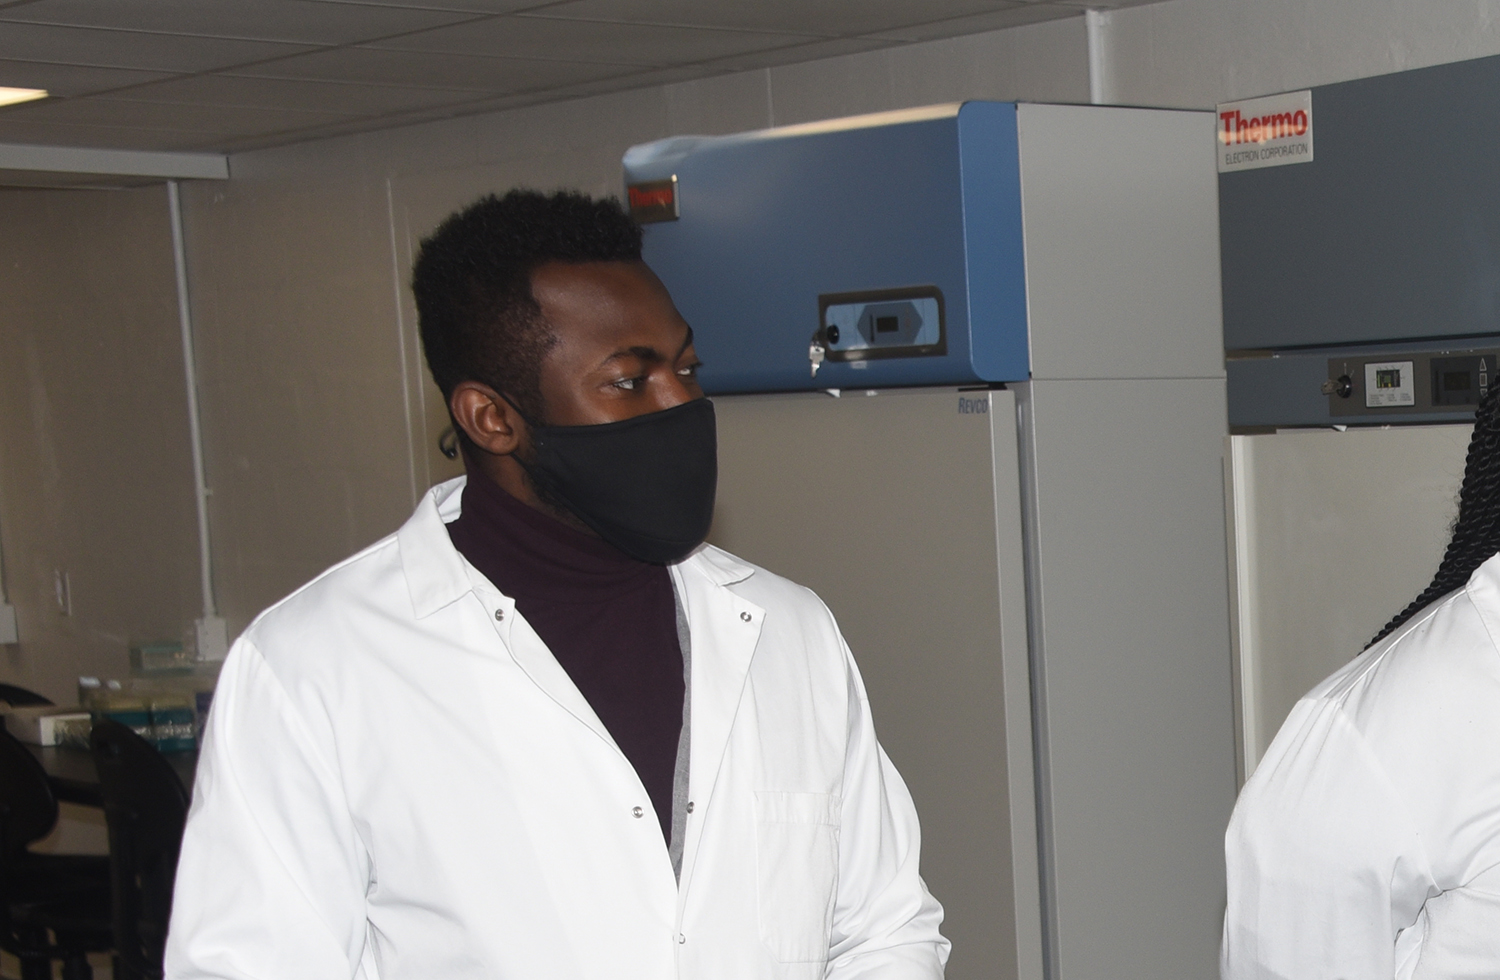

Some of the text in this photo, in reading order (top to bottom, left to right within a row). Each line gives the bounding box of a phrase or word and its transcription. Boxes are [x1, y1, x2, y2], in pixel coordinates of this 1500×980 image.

[1220, 110, 1308, 146] Thermo
[1226, 143, 1308, 165] ELECTRON CORPORATION
